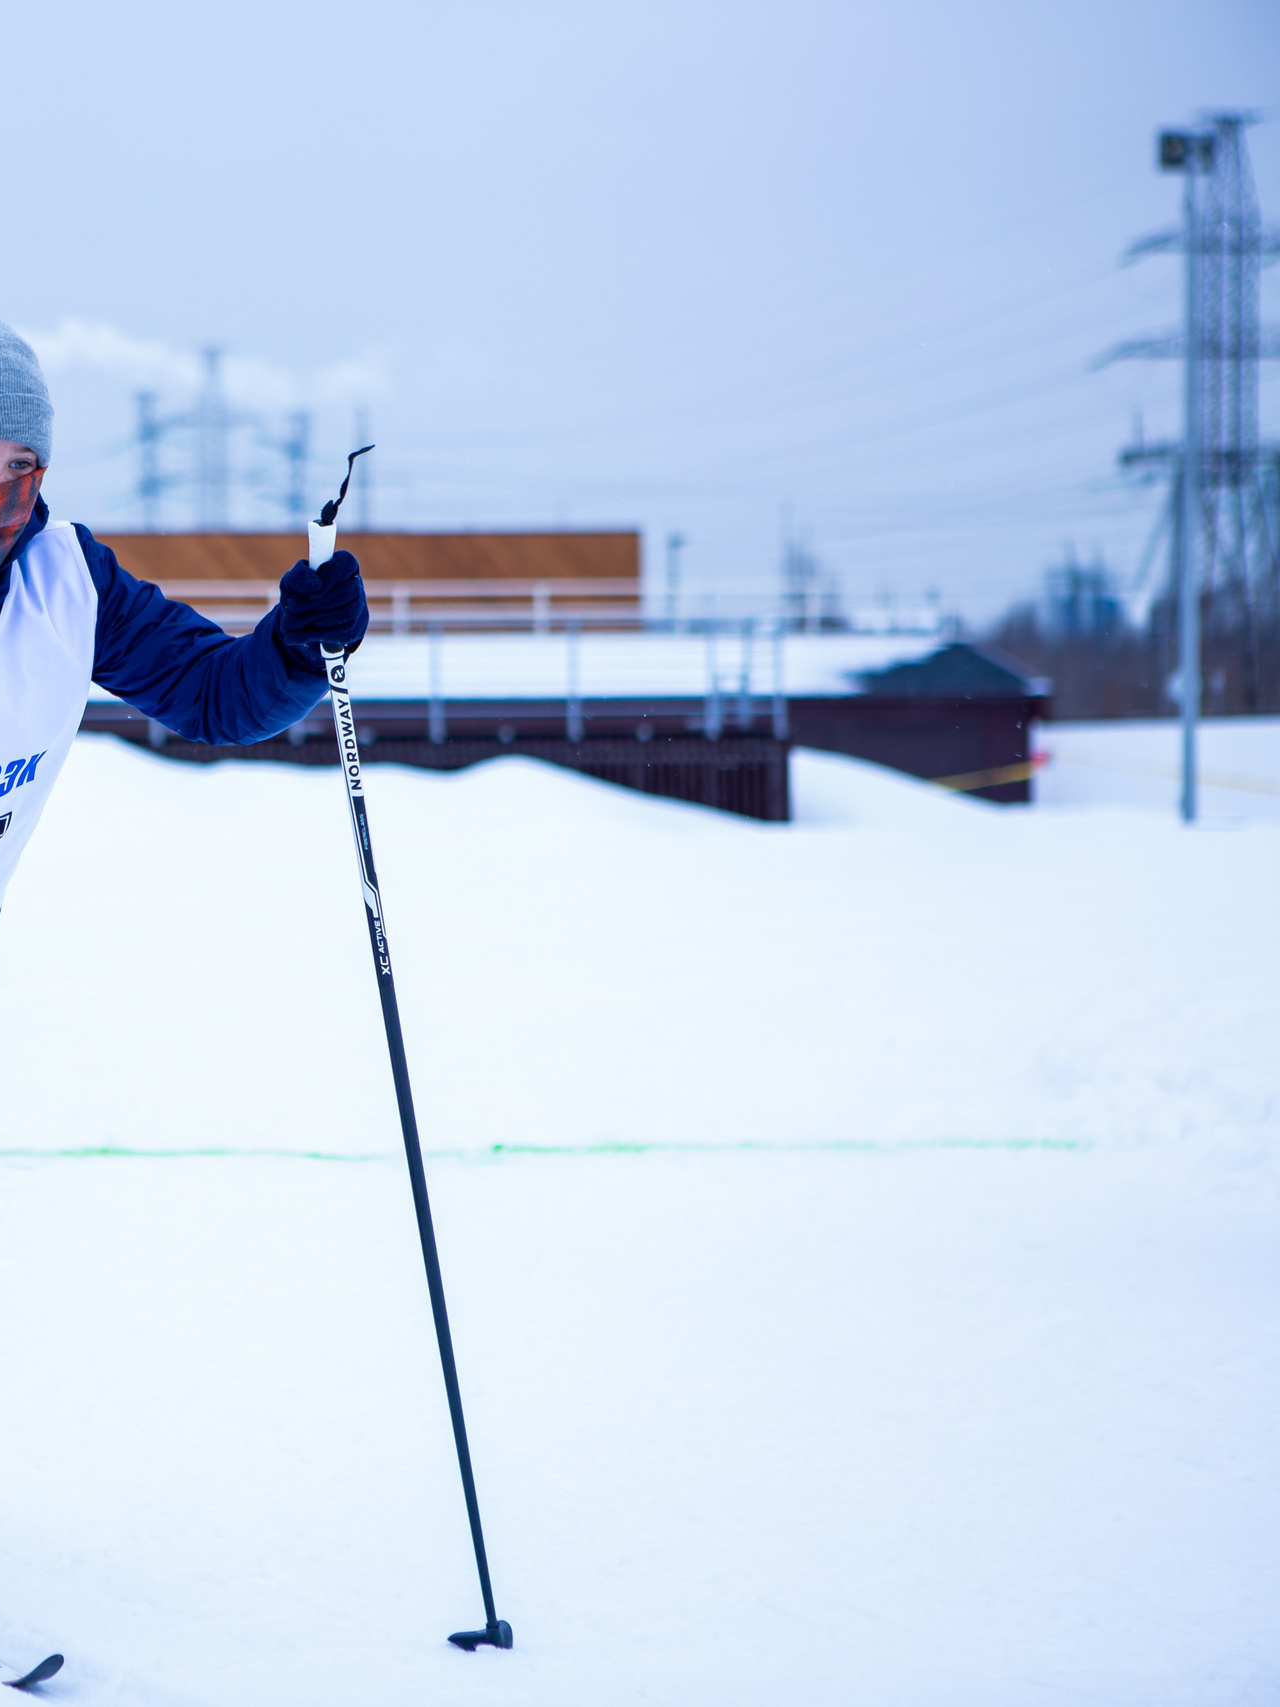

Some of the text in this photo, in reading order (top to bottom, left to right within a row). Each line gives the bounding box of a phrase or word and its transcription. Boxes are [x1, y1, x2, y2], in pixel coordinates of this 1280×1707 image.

[337, 698, 363, 791] NORDWAY
[373, 919, 392, 976] XC ACTIVE
